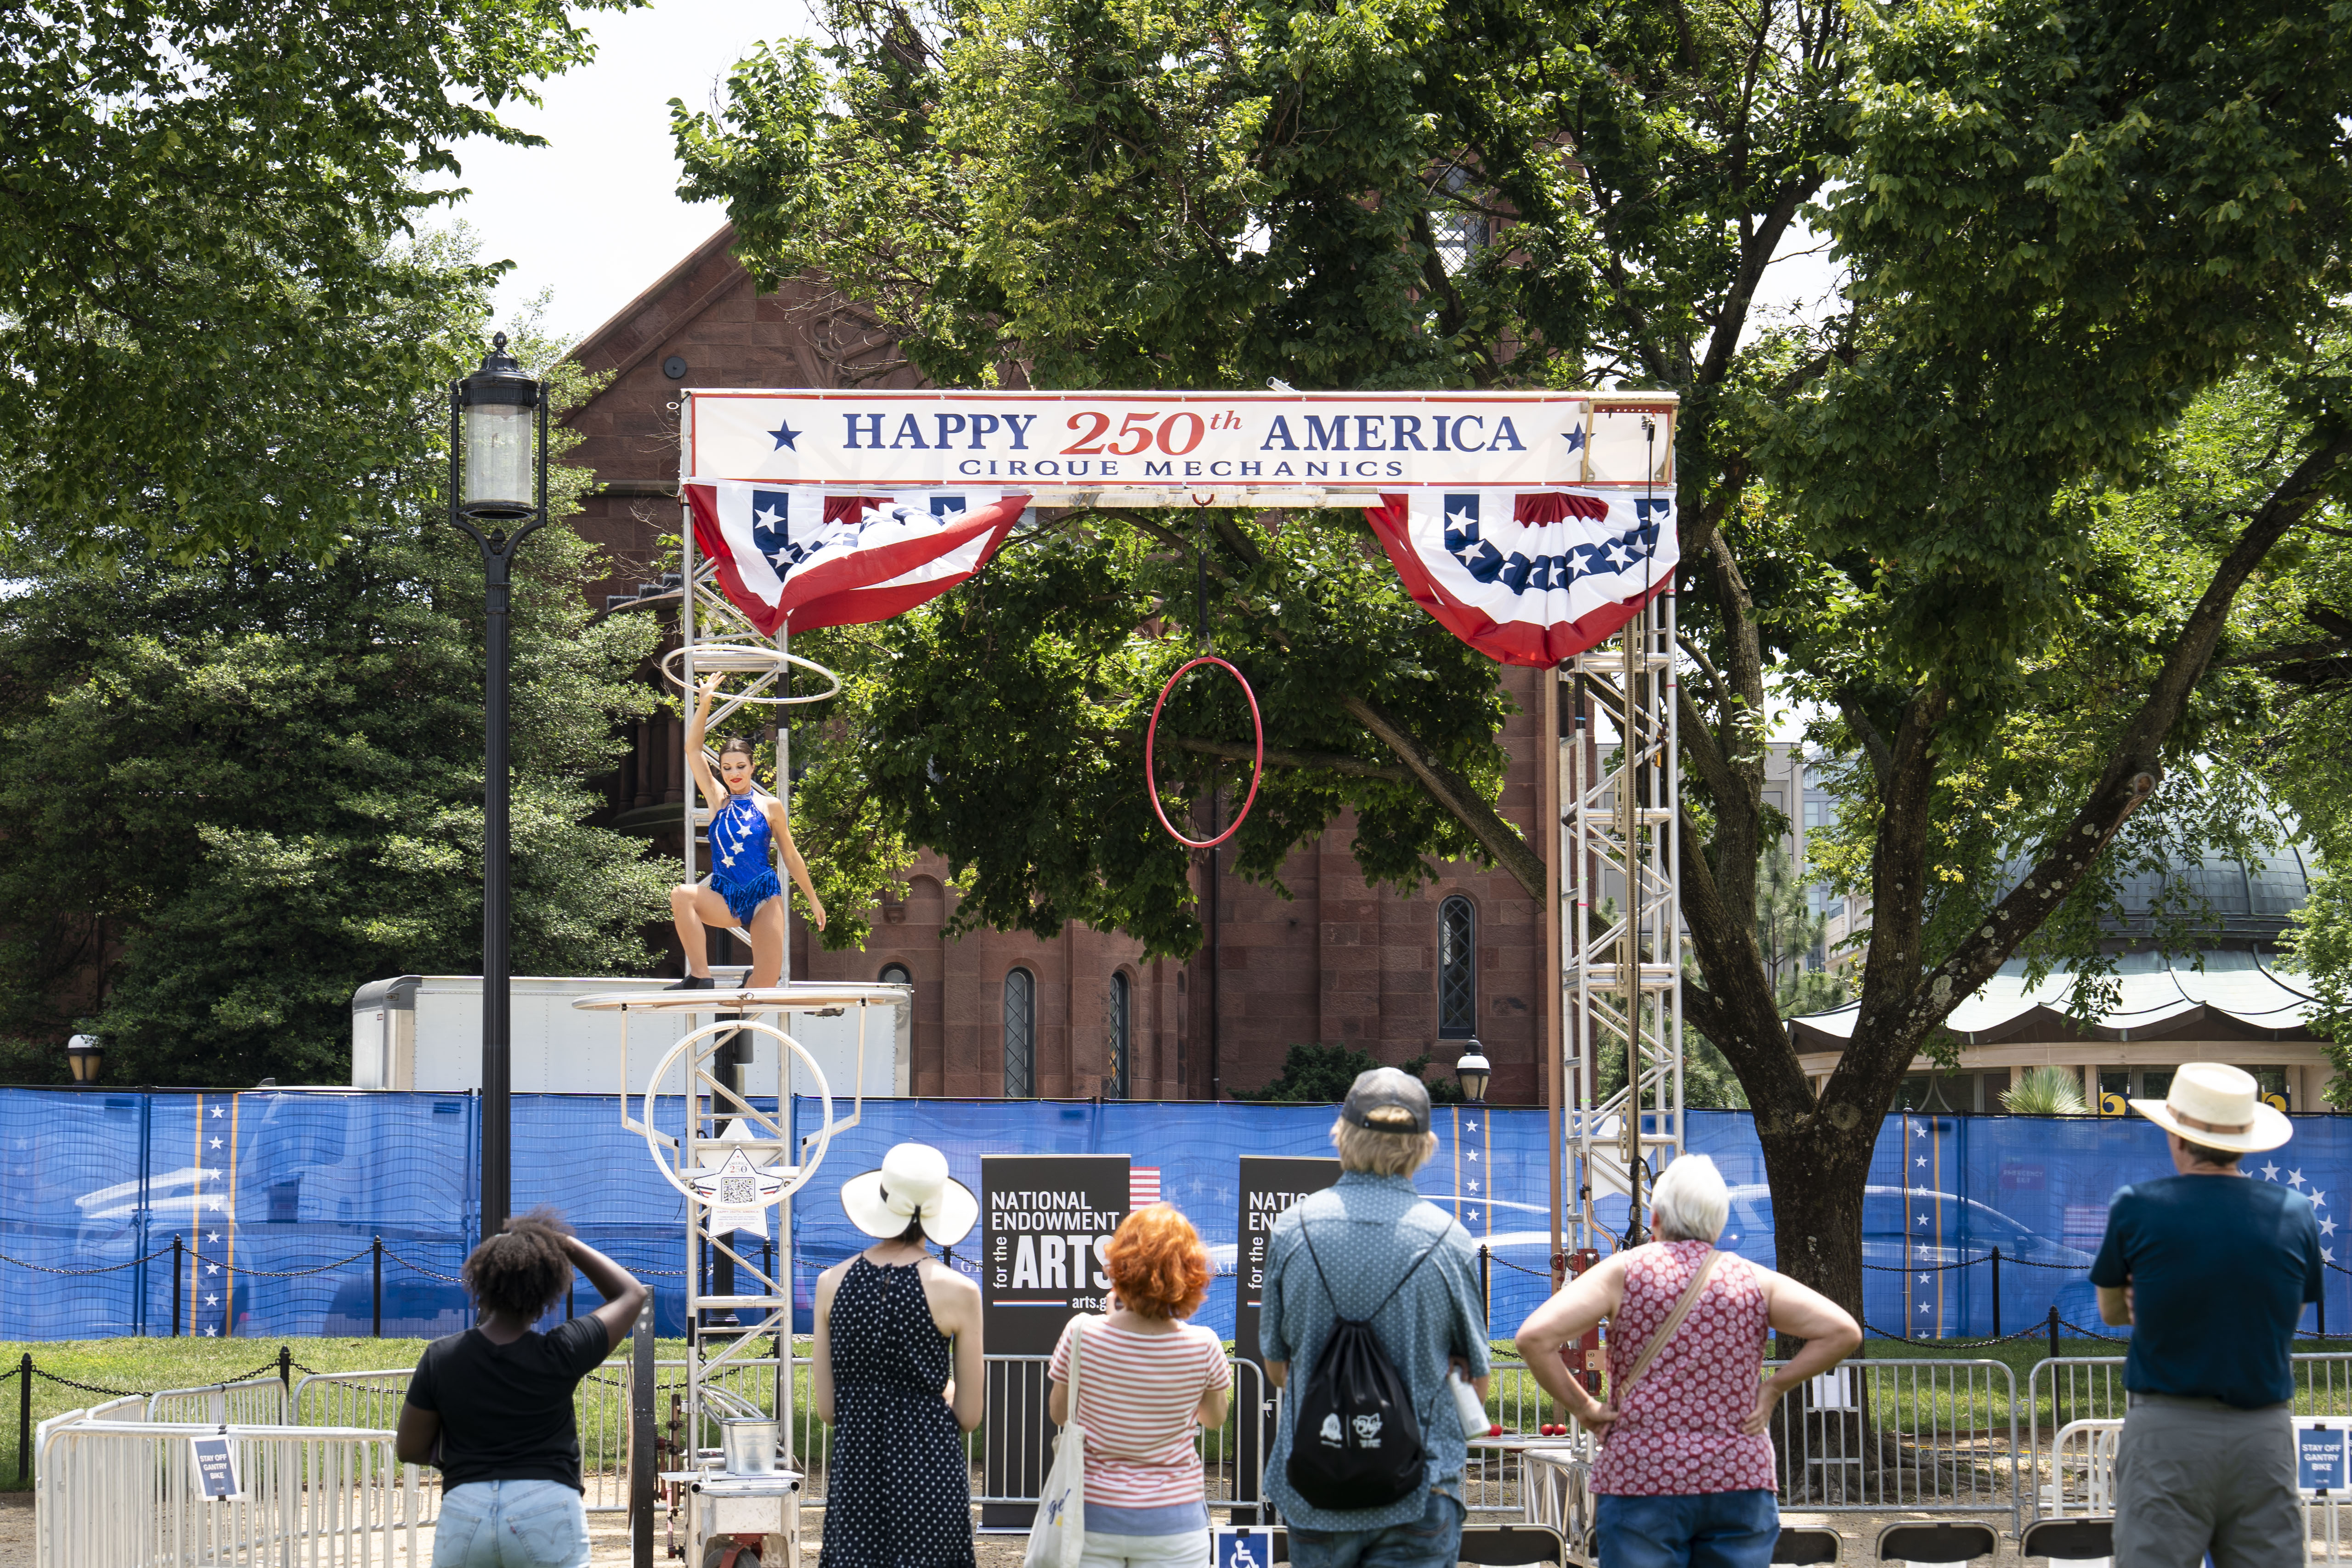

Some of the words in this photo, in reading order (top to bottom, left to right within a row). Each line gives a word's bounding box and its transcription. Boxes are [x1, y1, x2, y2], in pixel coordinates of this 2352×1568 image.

[842, 413, 1037, 449] HAPPY
[1059, 410, 1243, 456] 250th
[1260, 415, 1527, 452] AMERICA
[959, 459, 1119, 476] CIRQUE
[1143, 460, 1403, 476] MECHANICS
[991, 1191, 1092, 1210] NATIONAL
[992, 1211, 1120, 1231] ENDOWMENT
[992, 1236, 1007, 1262] the
[1249, 1236, 1264, 1262] the
[992, 1266, 1007, 1289] for
[1248, 1266, 1263, 1289] for
